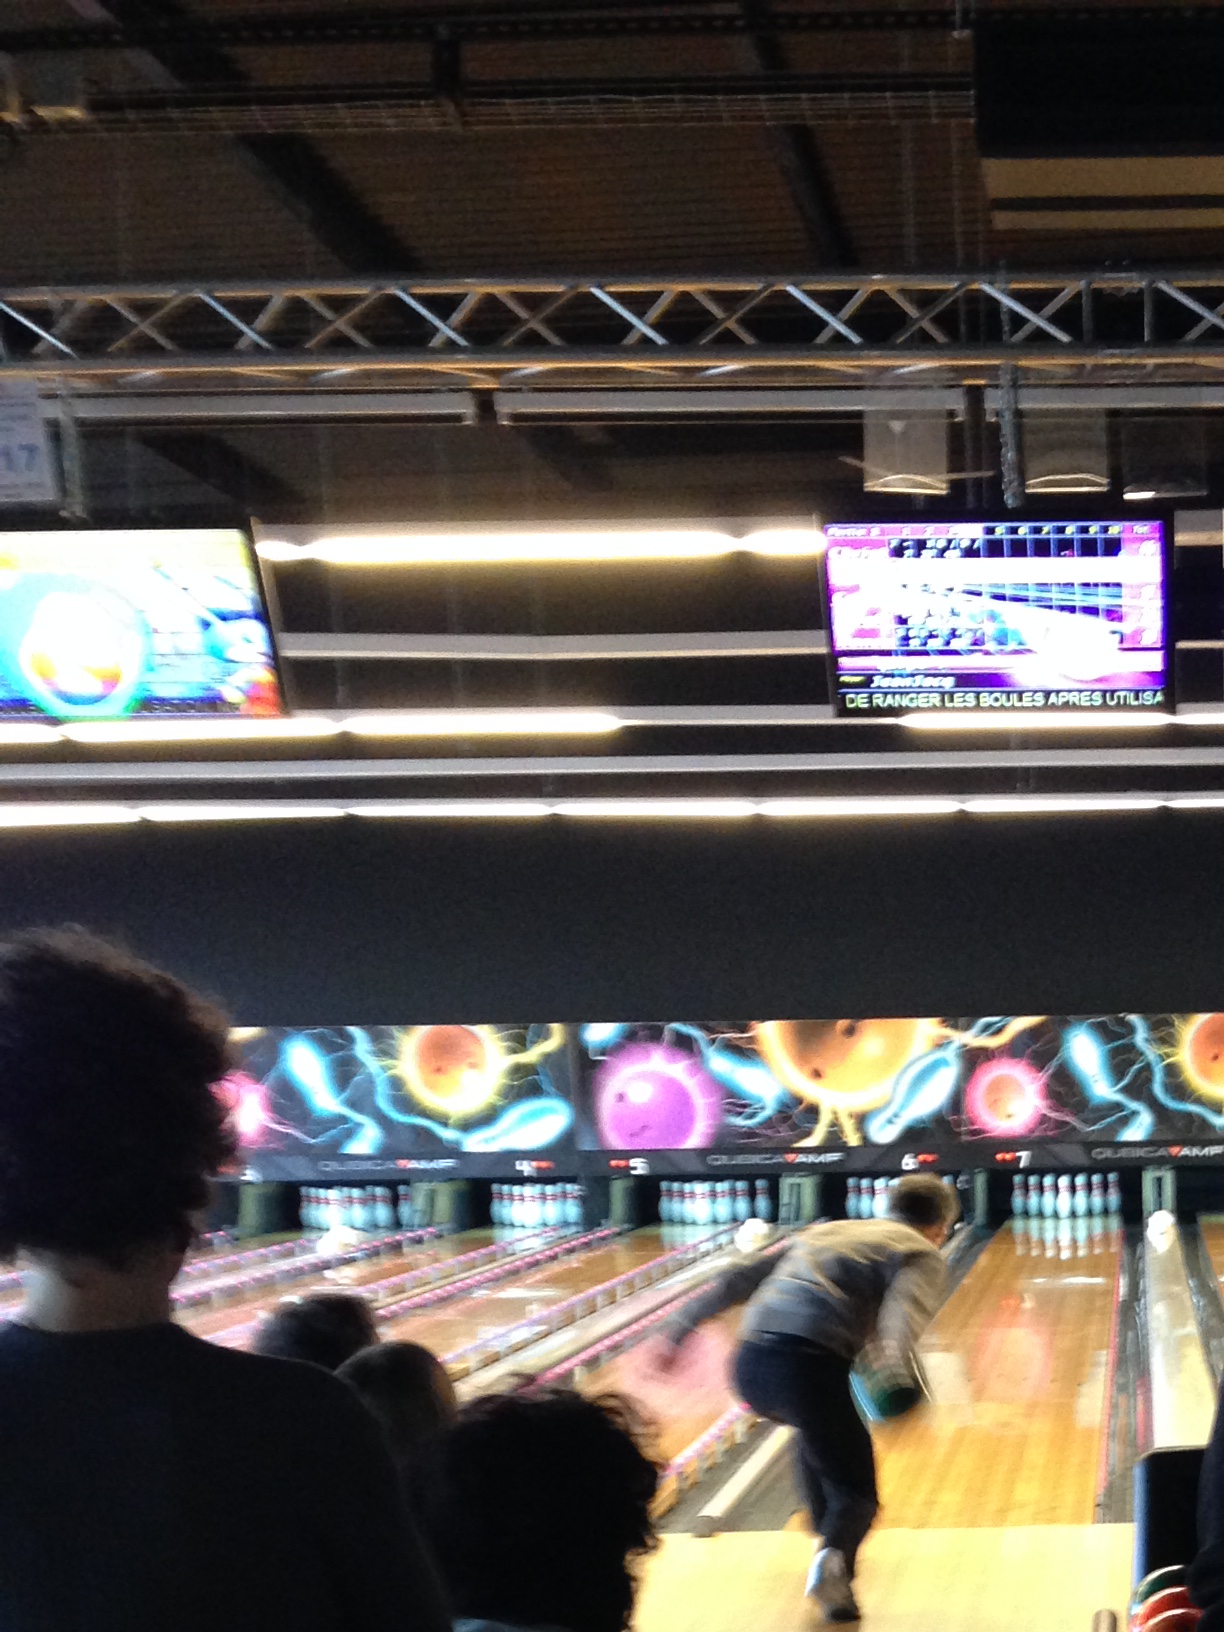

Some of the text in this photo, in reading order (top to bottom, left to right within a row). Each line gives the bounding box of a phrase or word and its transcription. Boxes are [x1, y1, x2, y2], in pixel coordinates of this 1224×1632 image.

[845, 693, 871, 709] DE
[872, 692, 942, 709] RANGER
[944, 692, 977, 708] LES
[981, 691, 1045, 708] BOULES
[1047, 691, 1102, 707] APRES
[515, 1158, 535, 1177] 4
[629, 1158, 650, 1175] 5
[901, 1154, 918, 1171] 6
[1015, 1151, 1032, 1169] 7
